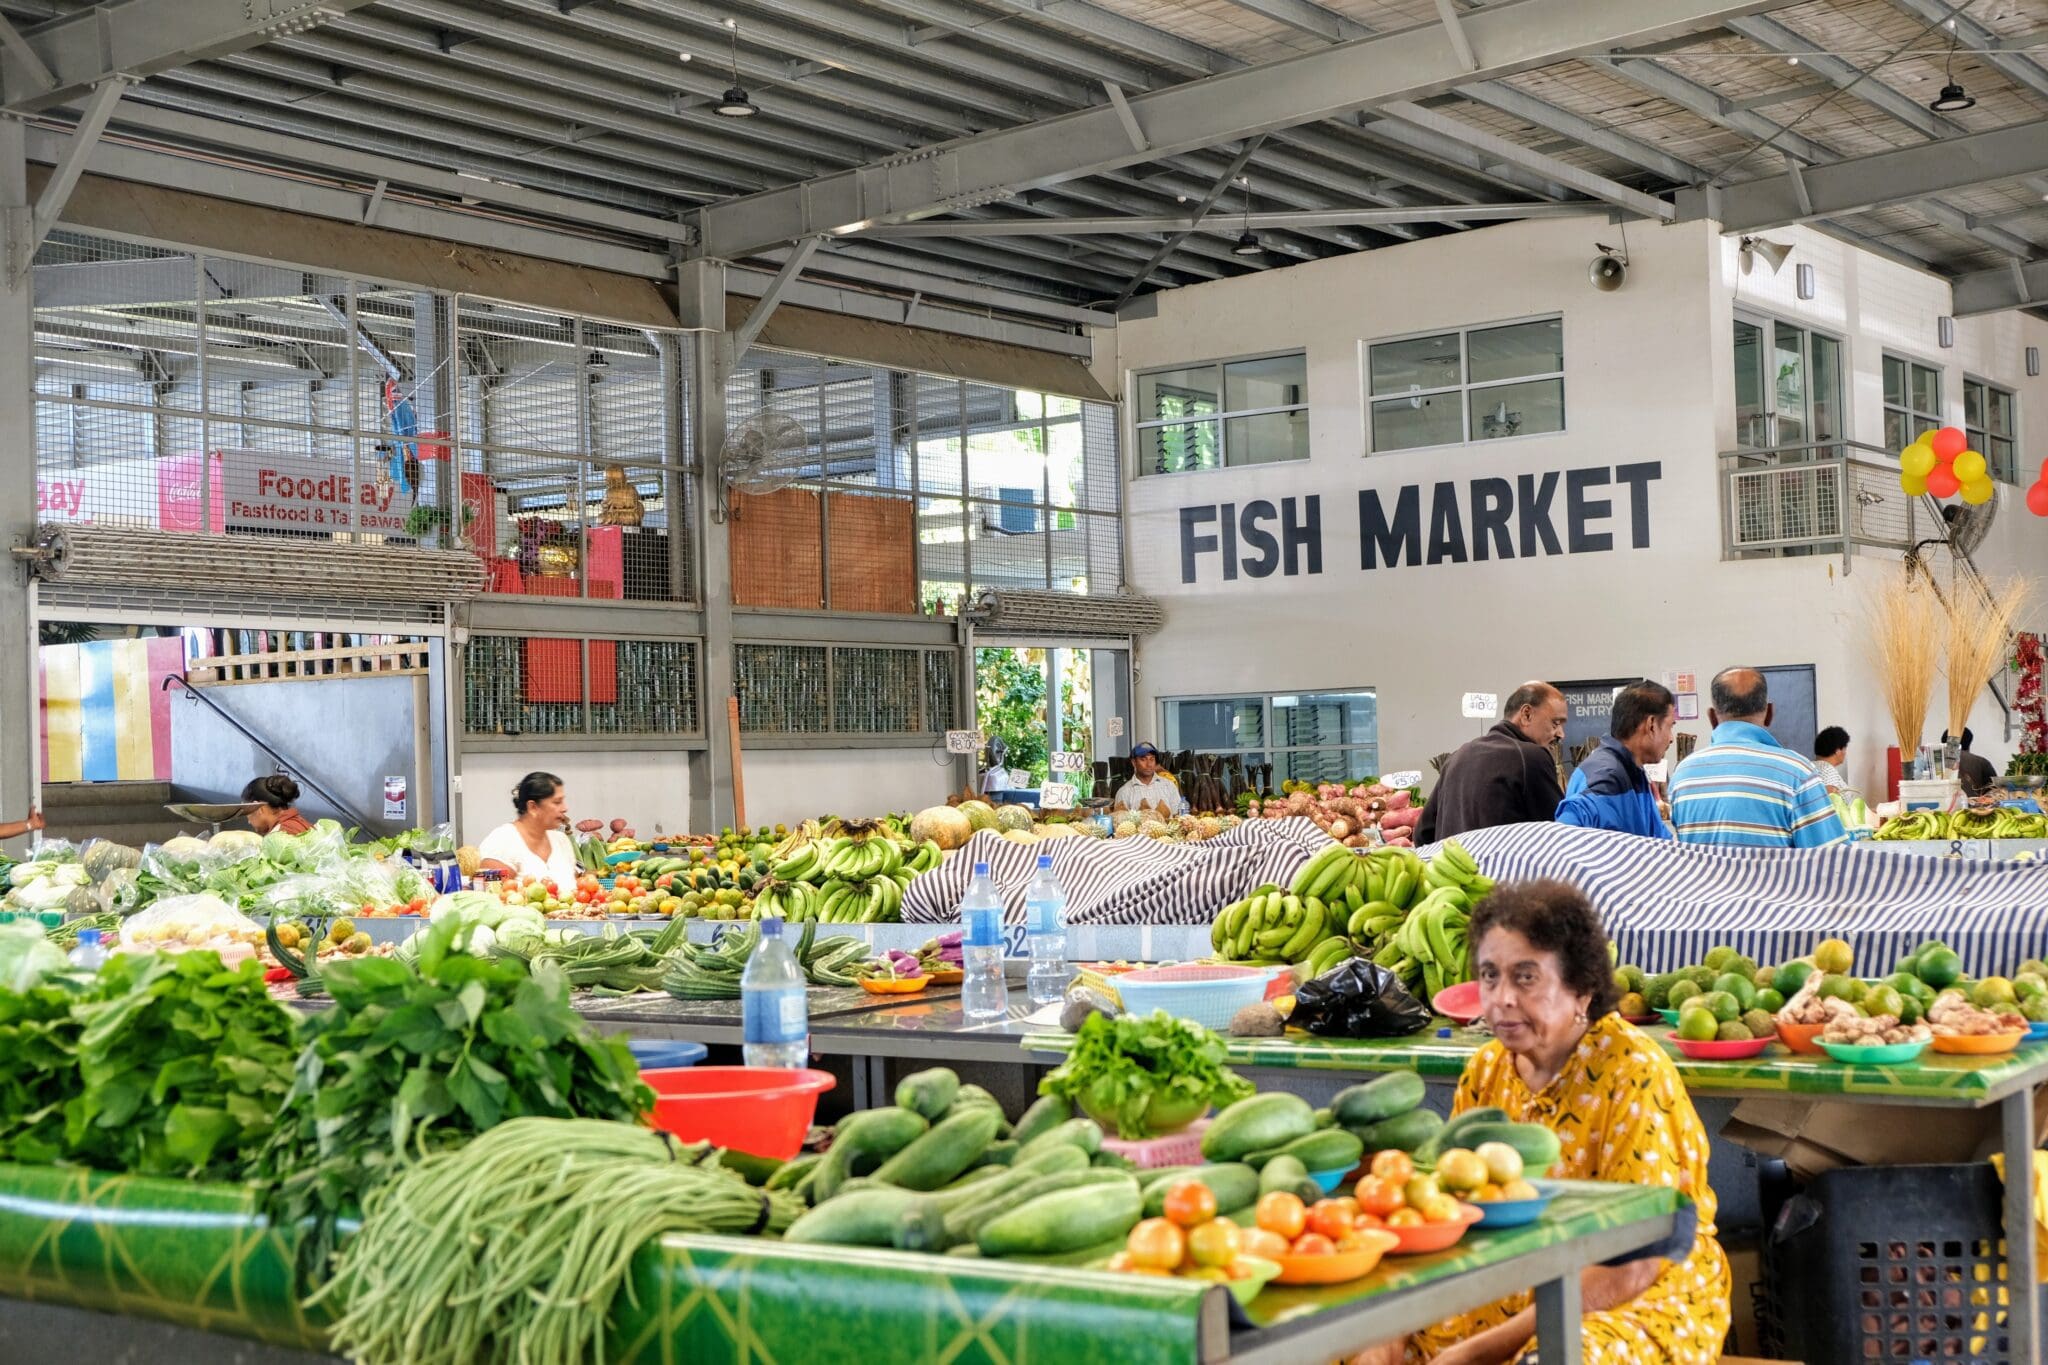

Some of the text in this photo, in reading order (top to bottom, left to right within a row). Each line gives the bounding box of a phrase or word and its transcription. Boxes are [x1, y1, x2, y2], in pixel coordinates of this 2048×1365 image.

[231, 501, 310, 523] Fastfood
[314, 507, 325, 524] &
[1179, 460, 1663, 584] FISH MARKET
[1587, 692, 1613, 705] MARK
[1575, 704, 1614, 717] ENTRY
